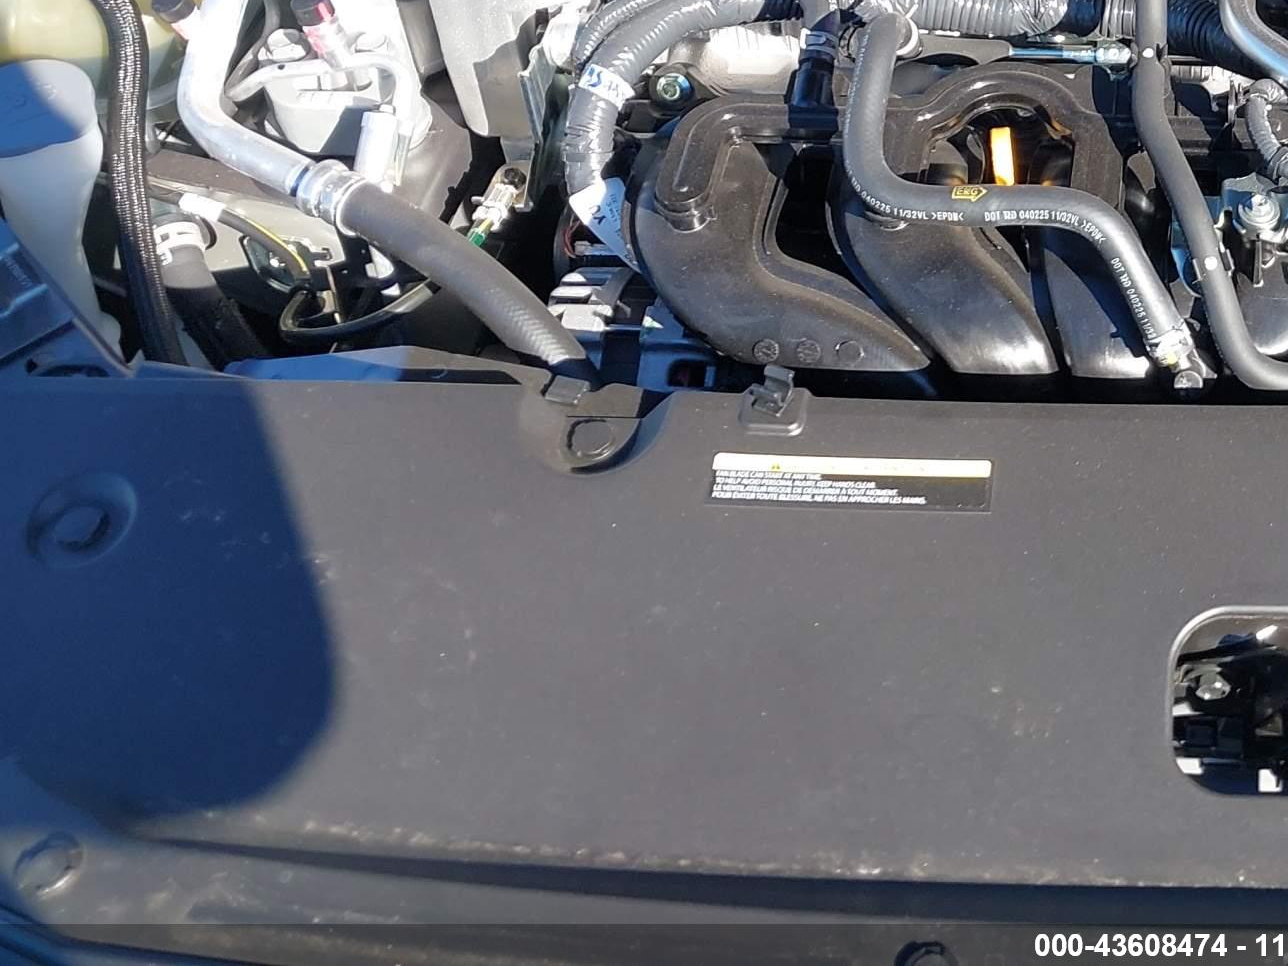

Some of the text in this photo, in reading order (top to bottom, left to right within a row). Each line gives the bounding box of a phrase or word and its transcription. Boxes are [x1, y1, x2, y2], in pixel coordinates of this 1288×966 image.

[861, 190, 891, 214] 040225
[893, 208, 929, 220] 11/32VL
[984, 210, 1001, 221] DOT
[1019, 210, 1050, 220] 040225
[1051, 211, 1080, 226] 11/32VL
[1126, 288, 1146, 318] 040225
